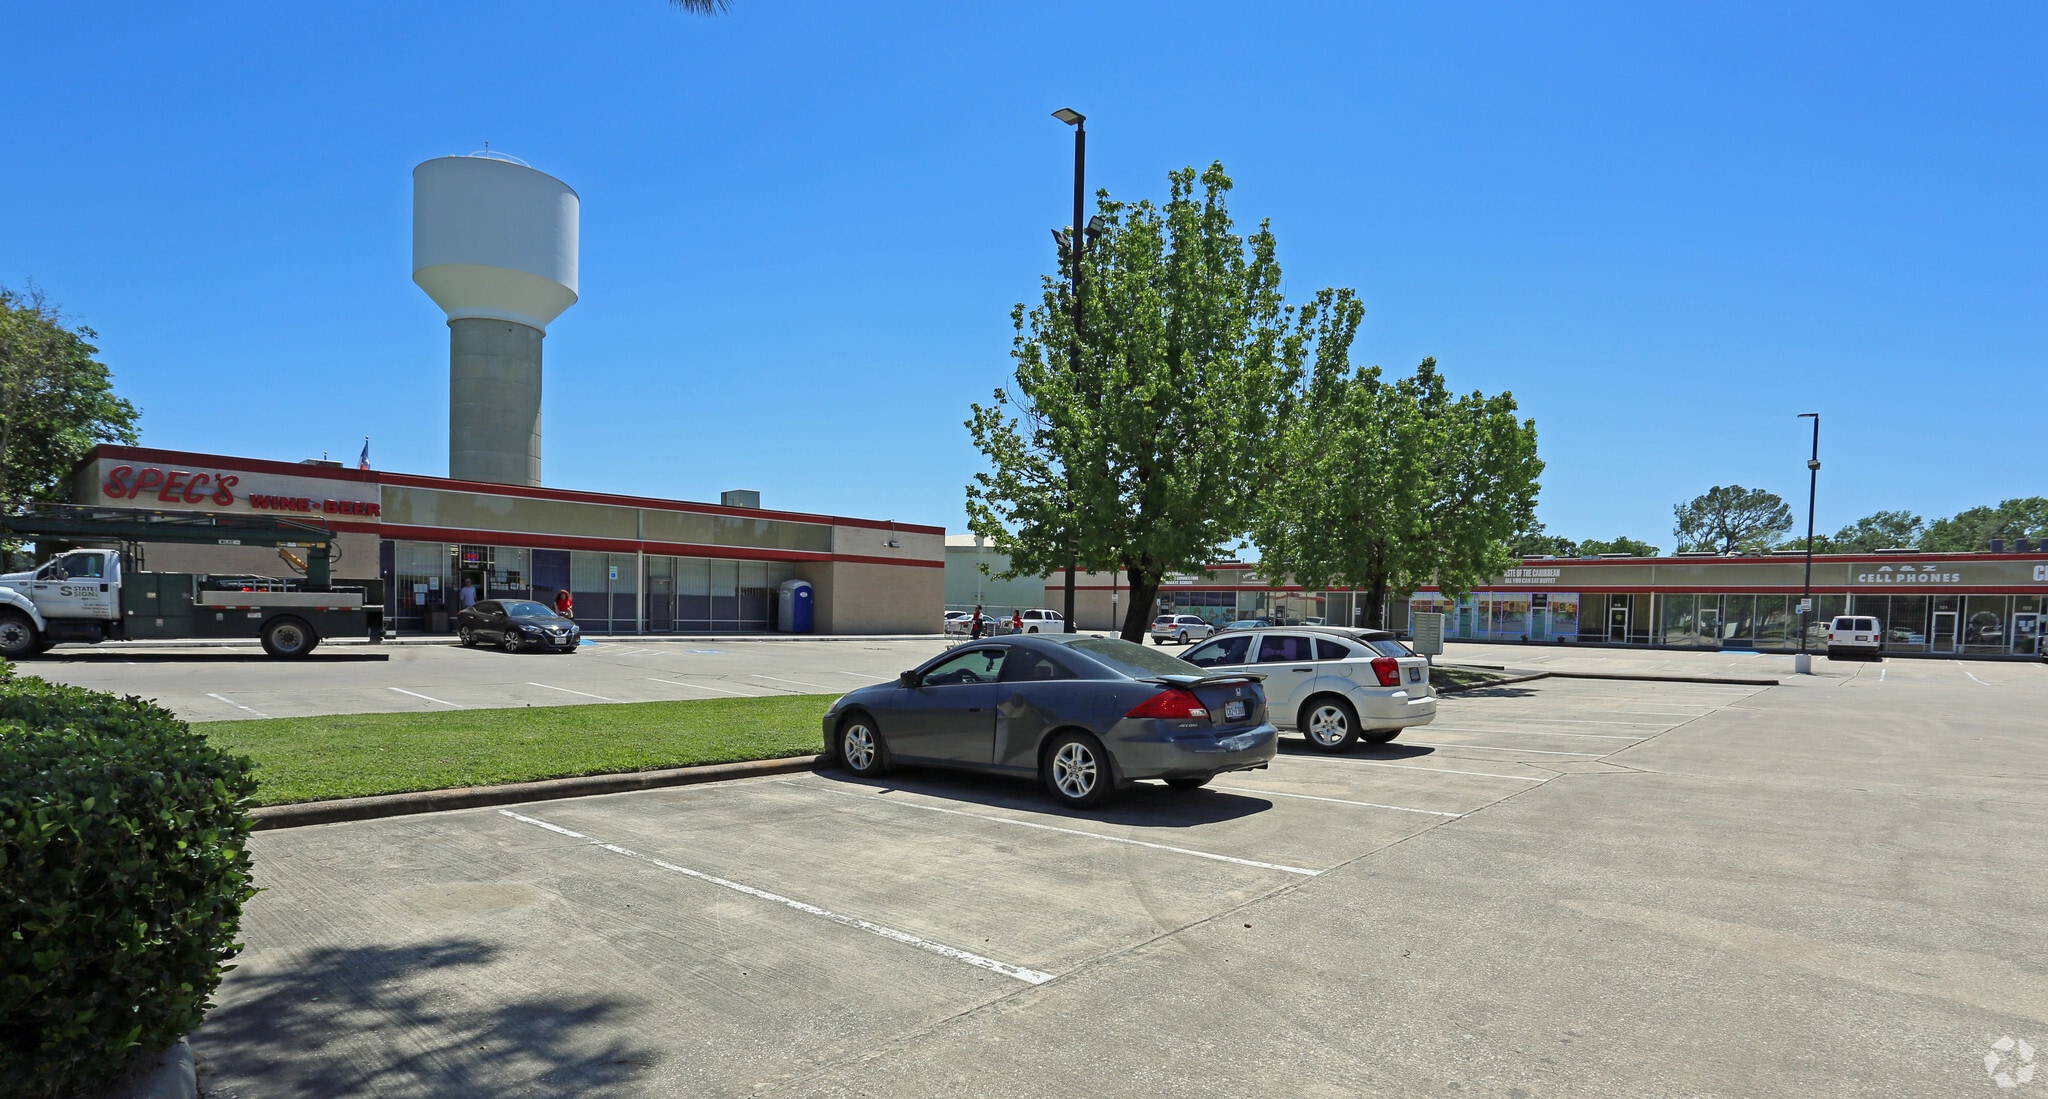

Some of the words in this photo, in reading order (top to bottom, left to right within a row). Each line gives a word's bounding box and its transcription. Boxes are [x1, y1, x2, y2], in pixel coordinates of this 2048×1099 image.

[103, 465, 239, 507] SPEC'S
[249, 493, 311, 513] WINE
[323, 499, 381, 516] BEER
[1858, 574, 1892, 583] CELL
[1896, 573, 1960, 583] PHONES
